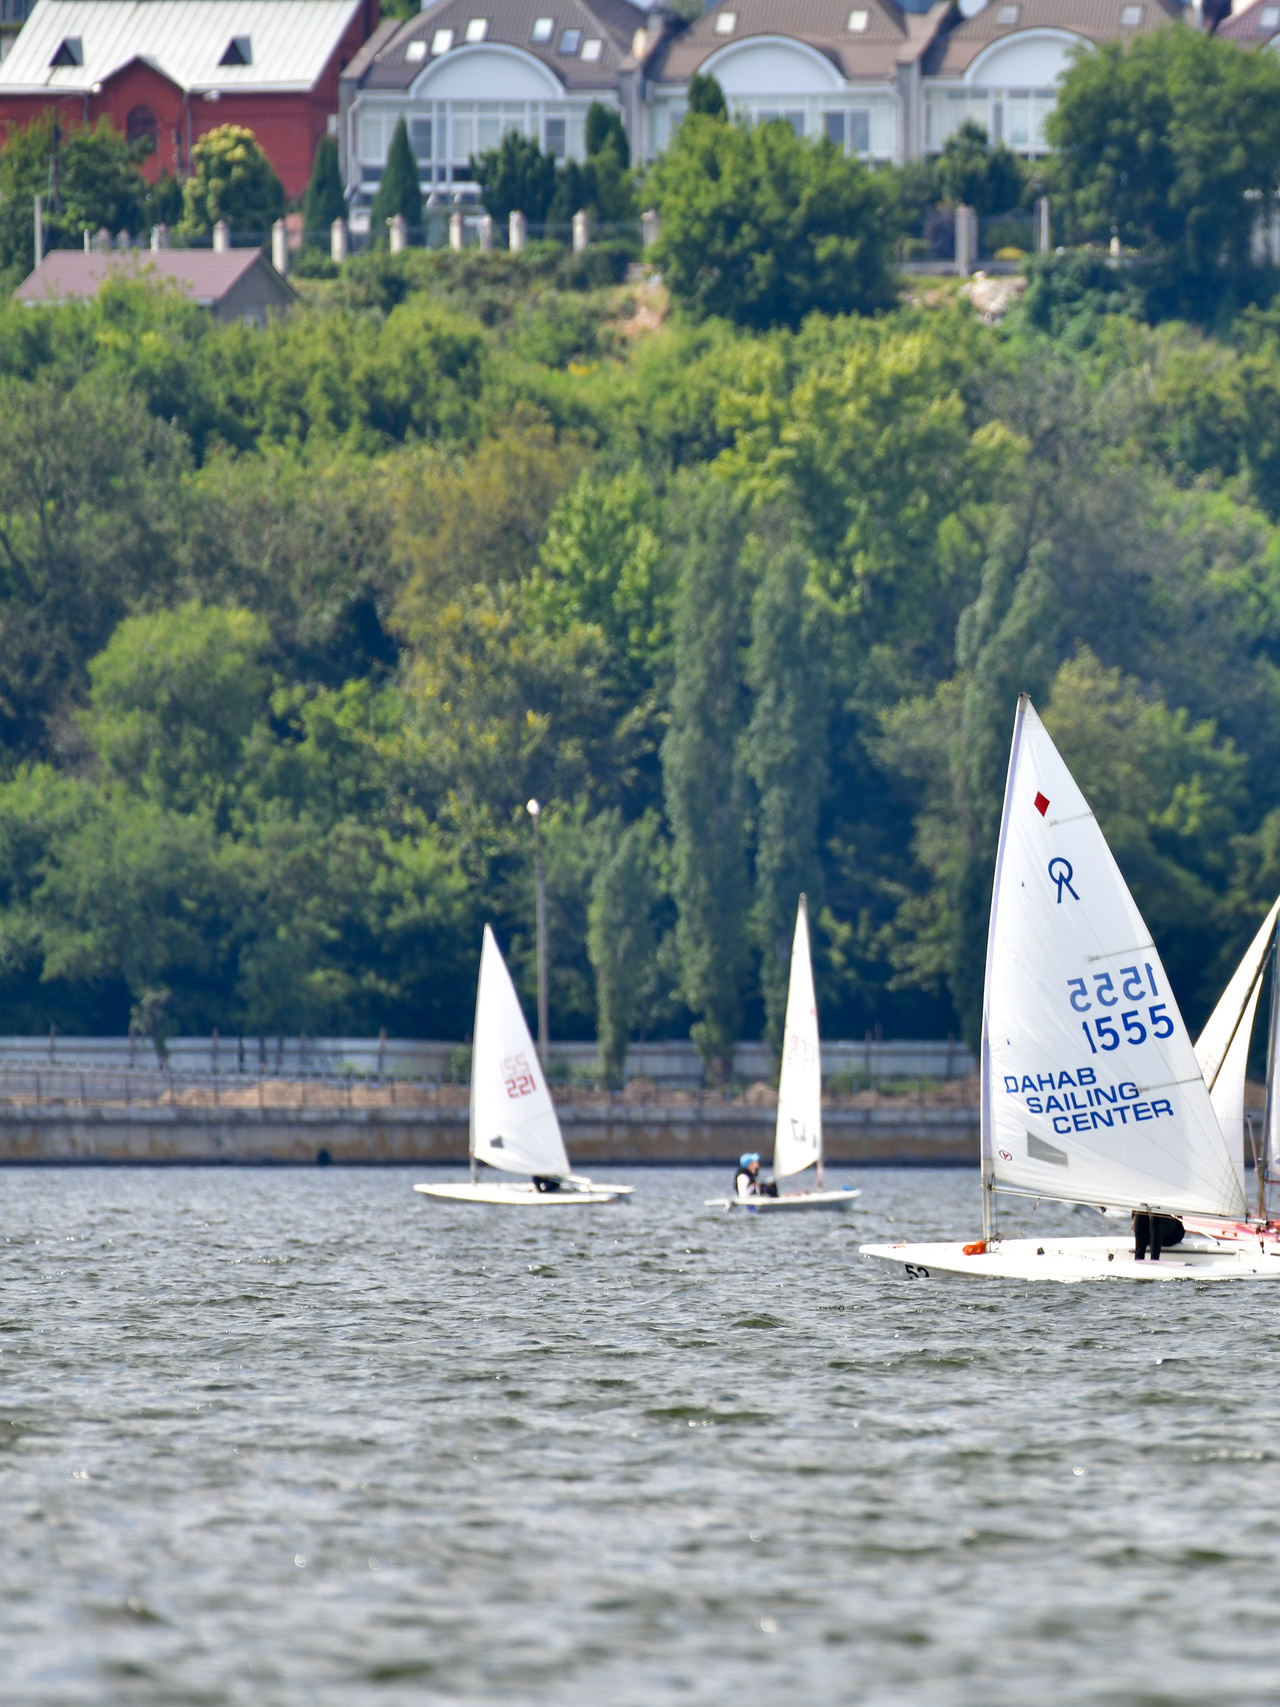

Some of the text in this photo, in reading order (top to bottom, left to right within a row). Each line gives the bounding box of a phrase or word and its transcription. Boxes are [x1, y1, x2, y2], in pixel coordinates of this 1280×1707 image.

[1082, 1003, 1174, 1054] 1555
[505, 1074, 537, 1099] 221
[1004, 1067, 1097, 1093] DAHAB
[1026, 1082, 1140, 1114] SAILING
[1052, 1099, 1174, 1134] CENTER
